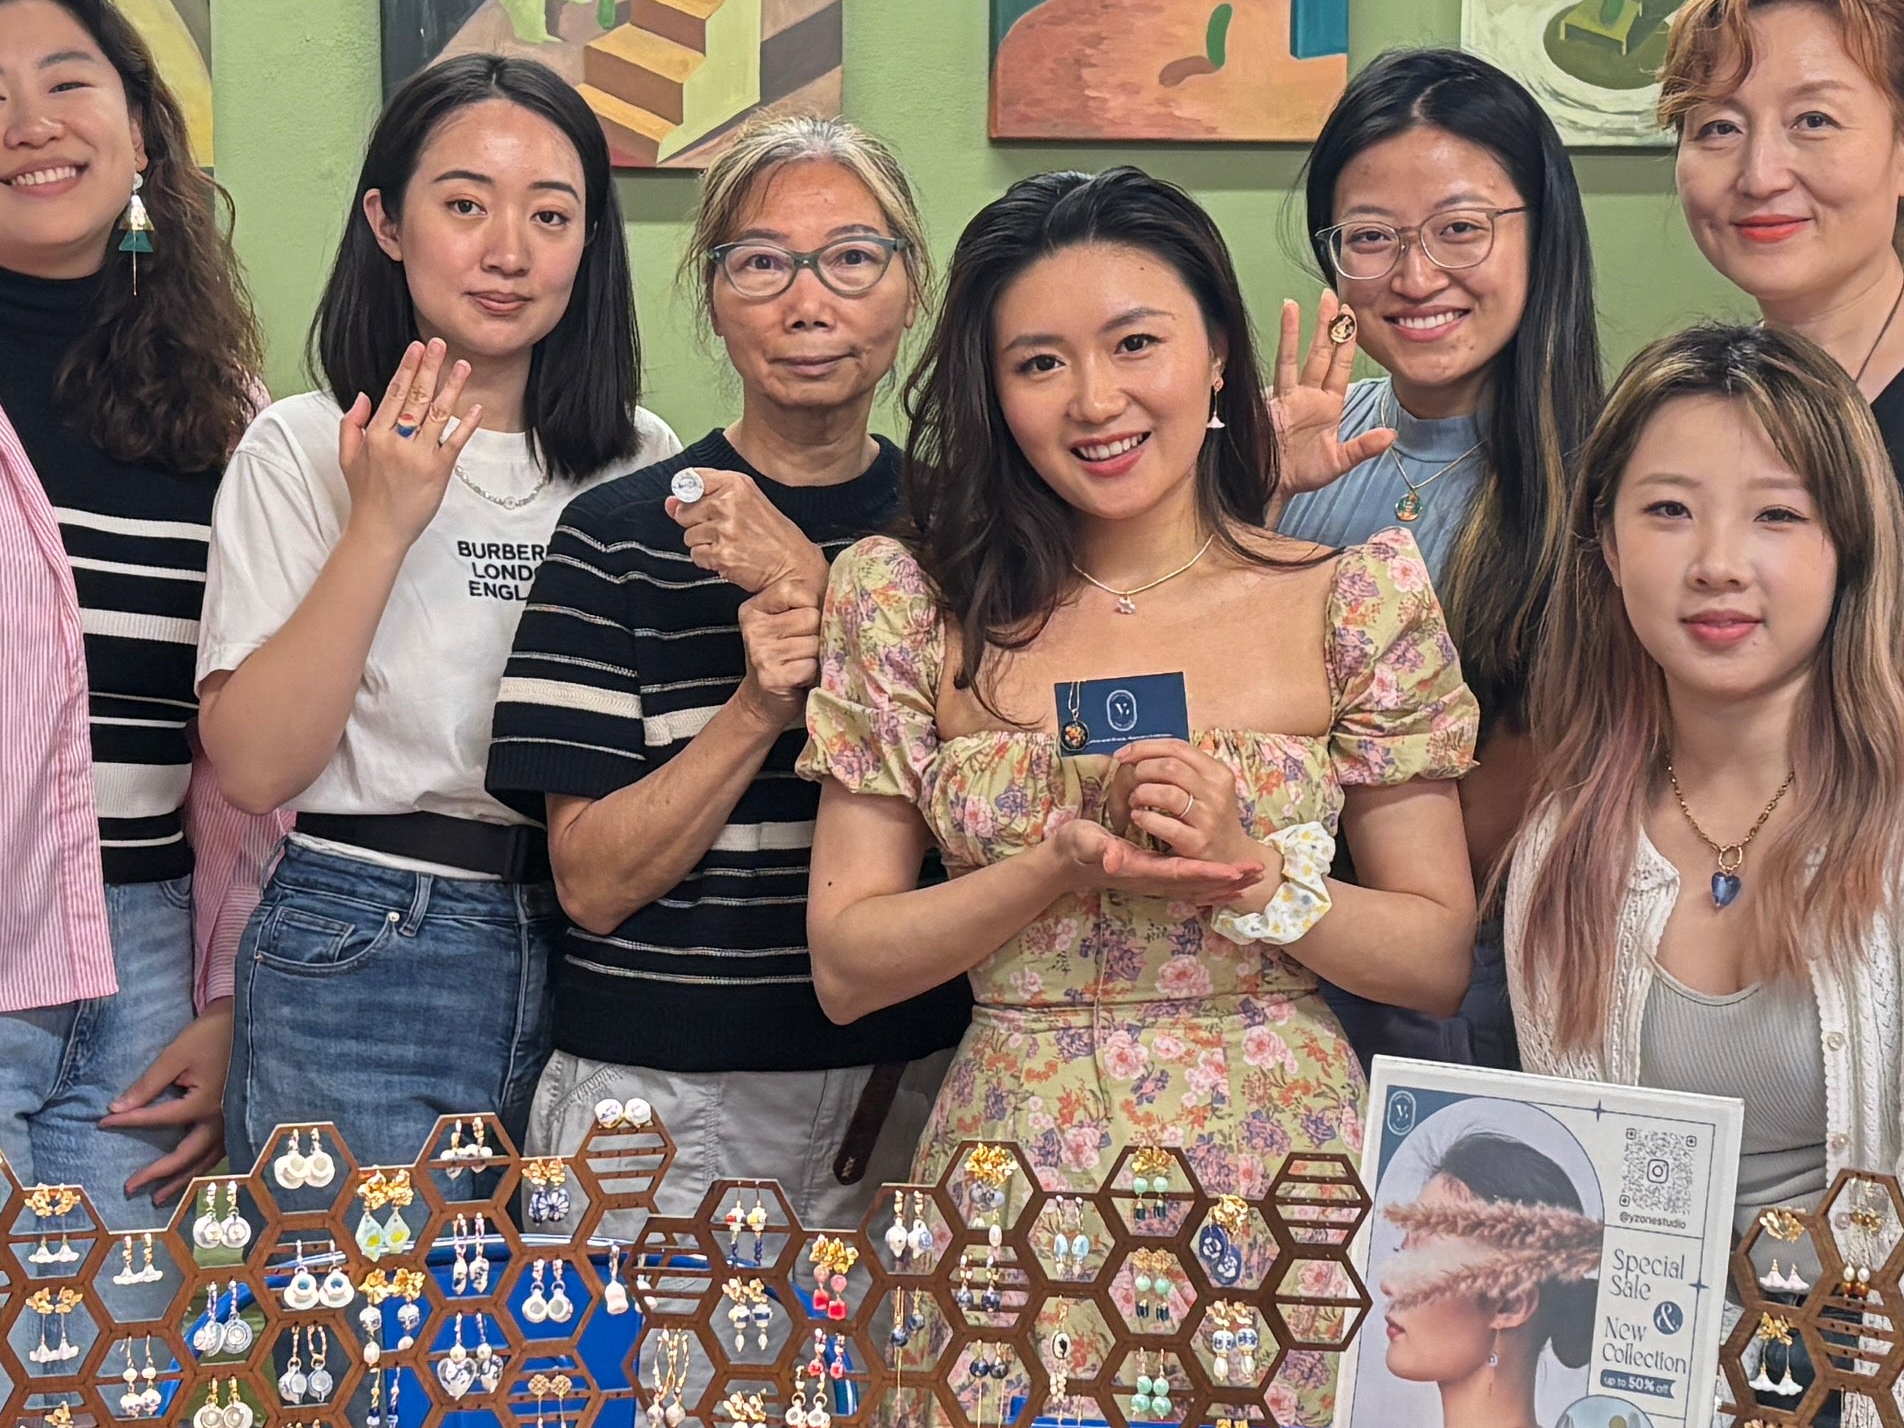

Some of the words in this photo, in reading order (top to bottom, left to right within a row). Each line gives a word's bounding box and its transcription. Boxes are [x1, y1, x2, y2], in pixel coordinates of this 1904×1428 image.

[457, 540, 549, 561] BURBER
[472, 561, 535, 581] LOND
[468, 580, 528, 601] ENGL
[1619, 1211, 1687, 1229] @yzonestudio
[1612, 1248, 1685, 1280] Special
[1609, 1274, 1651, 1300] Sale
[1604, 1315, 1647, 1342] New
[1656, 1303, 1679, 1332] &
[1602, 1342, 1687, 1374] Collection
[1603, 1376, 1616, 1386] up
[1617, 1378, 1627, 1387] to
[1628, 1376, 1655, 1392] 50%
[1656, 1383, 1670, 1394] off
